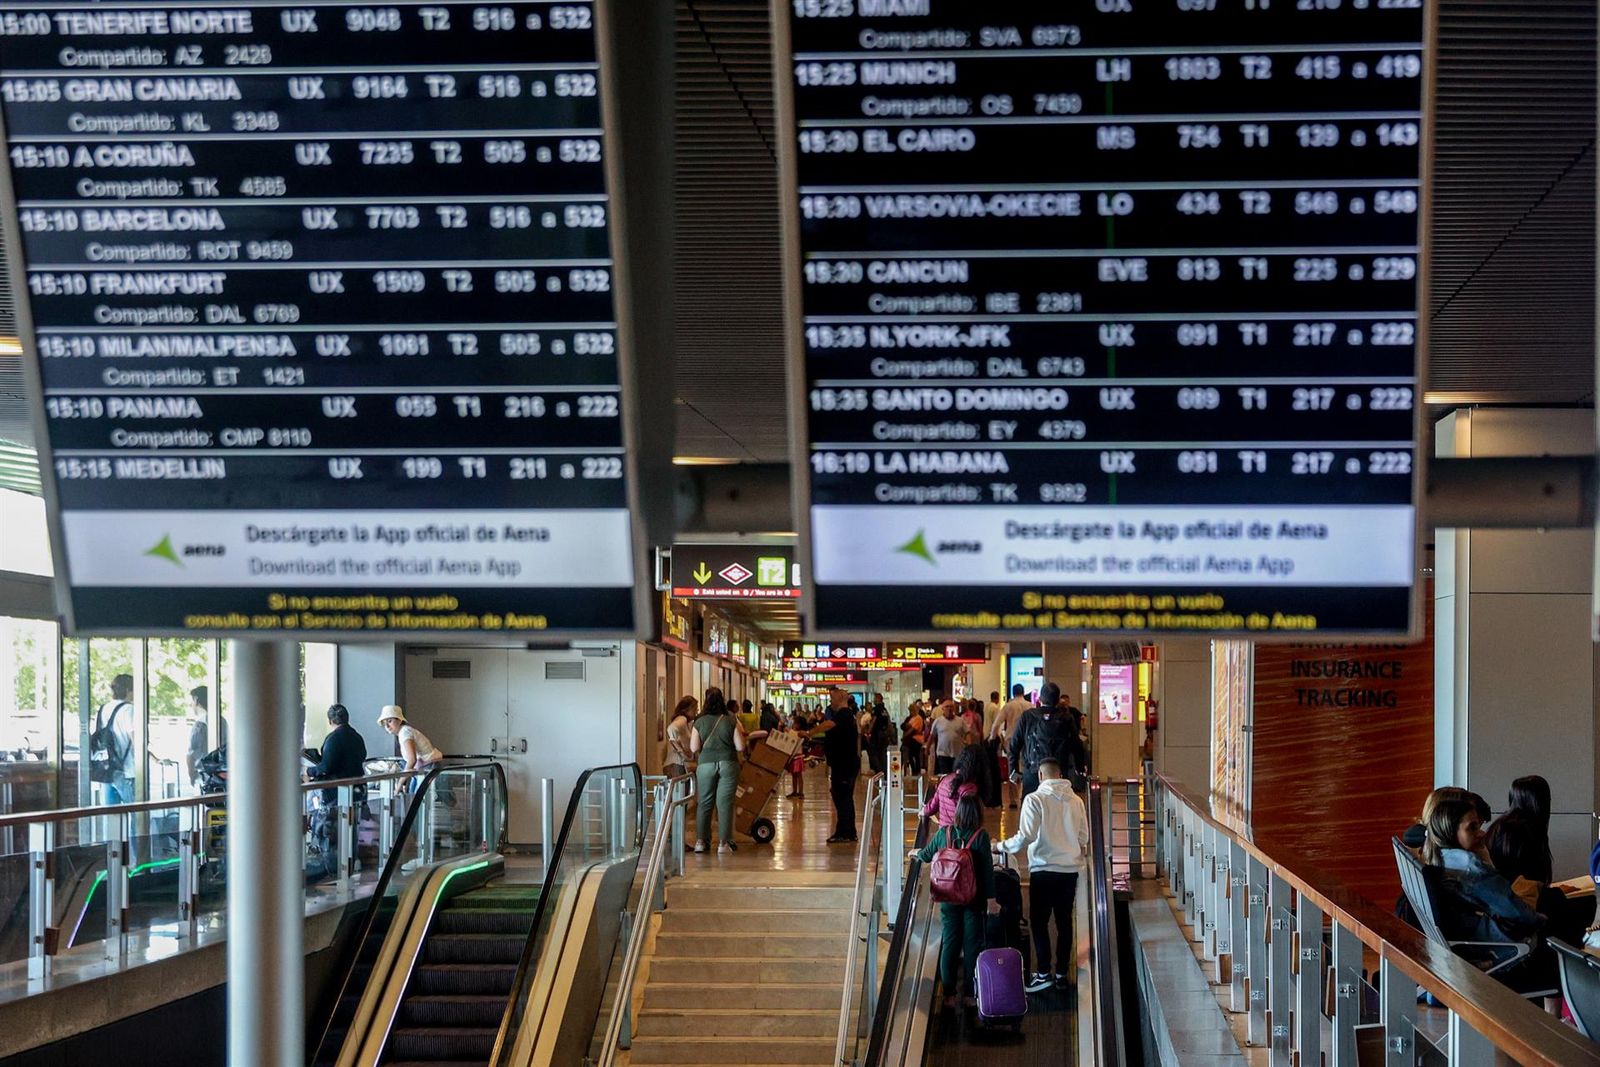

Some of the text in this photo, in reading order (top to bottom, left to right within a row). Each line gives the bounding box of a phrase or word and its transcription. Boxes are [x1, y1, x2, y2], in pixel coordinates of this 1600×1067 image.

[54, 11, 169, 34] TENERIFE
[170, 11, 254, 34] NORTE
[281, 10, 318, 32] UX
[418, 8, 450, 30] T2
[473, 8, 516, 30] 516
[550, 7, 592, 29] 532
[58, 46, 204, 69] Compartido: AZ
[795, 58, 1131, 85] 15:25 MUNICH LH
[1, 74, 597, 101] 15:05 GRAN CANARIA UX 9164 T2 516 532
[67, 112, 211, 135] Compartido: KL
[862, 130, 896, 152] EL
[897, 128, 976, 151] CAIRO
[1097, 126, 1135, 149] MS
[10, 145, 70, 167] 15:10
[72, 145, 95, 167] A
[94, 141, 195, 166] CORUÑA
[295, 143, 332, 165] UX
[430, 141, 462, 163] T2
[484, 141, 526, 163] 505
[559, 140, 601, 162] 532
[76, 178, 220, 200] Compartido: TK
[864, 194, 1081, 217] VARSOVIA-OKECIE
[1097, 193, 1134, 216] LO
[20, 210, 78, 232] 15:10
[81, 209, 226, 231] BARCELONA
[302, 208, 338, 229] UX
[365, 207, 420, 228] 7703
[436, 206, 468, 228] T2
[564, 205, 606, 227] 532
[85, 241, 242, 262] Compartido: ROT
[28, 269, 611, 295] 15:10 FRANKFURT UX 1509 T2 505 532
[867, 261, 969, 283] CANCUN
[1098, 259, 1148, 281] EVE
[94, 304, 246, 325] Compartido: DAL
[38, 337, 95, 357] 15:10
[99, 335, 297, 357] MILAN/MALPENSA
[315, 334, 351, 356] UX
[447, 333, 478, 355] T2
[500, 333, 541, 355] 505
[573, 332, 615, 354] 532
[1099, 323, 1135, 346] UX
[102, 366, 305, 387] Compartido: ET 1421
[48, 398, 104, 418] 15:10
[106, 397, 203, 418] PANAMA
[321, 396, 357, 417] UX
[453, 396, 481, 417] T1
[504, 396, 546, 417] 216
[577, 396, 619, 417] 222
[871, 389, 953, 411] SANTO
[955, 388, 1069, 411] DOMINGO
[1100, 388, 1135, 410] UX
[110, 429, 214, 449] Compartido:
[219, 428, 264, 446] CMP
[55, 459, 112, 479] 15:15
[115, 458, 226, 479] MEDELLIN
[328, 457, 363, 479] UX
[458, 457, 486, 478] T1
[509, 457, 547, 479] 211
[582, 457, 623, 479] 222
[874, 452, 908, 474] LA
[909, 452, 1010, 474] HABANA
[1100, 451, 1136, 473] UX
[246, 523, 550, 548] Descárgate la App oficial de Aena
[1005, 520, 1327, 543] Descárgate la App oficial de Aena
[184, 543, 226, 557] aena
[250, 556, 521, 579] Download the official Aena App
[759, 559, 785, 583] T2
[1006, 554, 1294, 576] Download the official Aena App
[268, 594, 458, 610] Si no encuentra un vuelo
[184, 612, 547, 629] consulte con el Servicio de Información de Aena
[1291, 660, 1402, 679] INSURANCE
[1295, 688, 1398, 708] TRACKING
